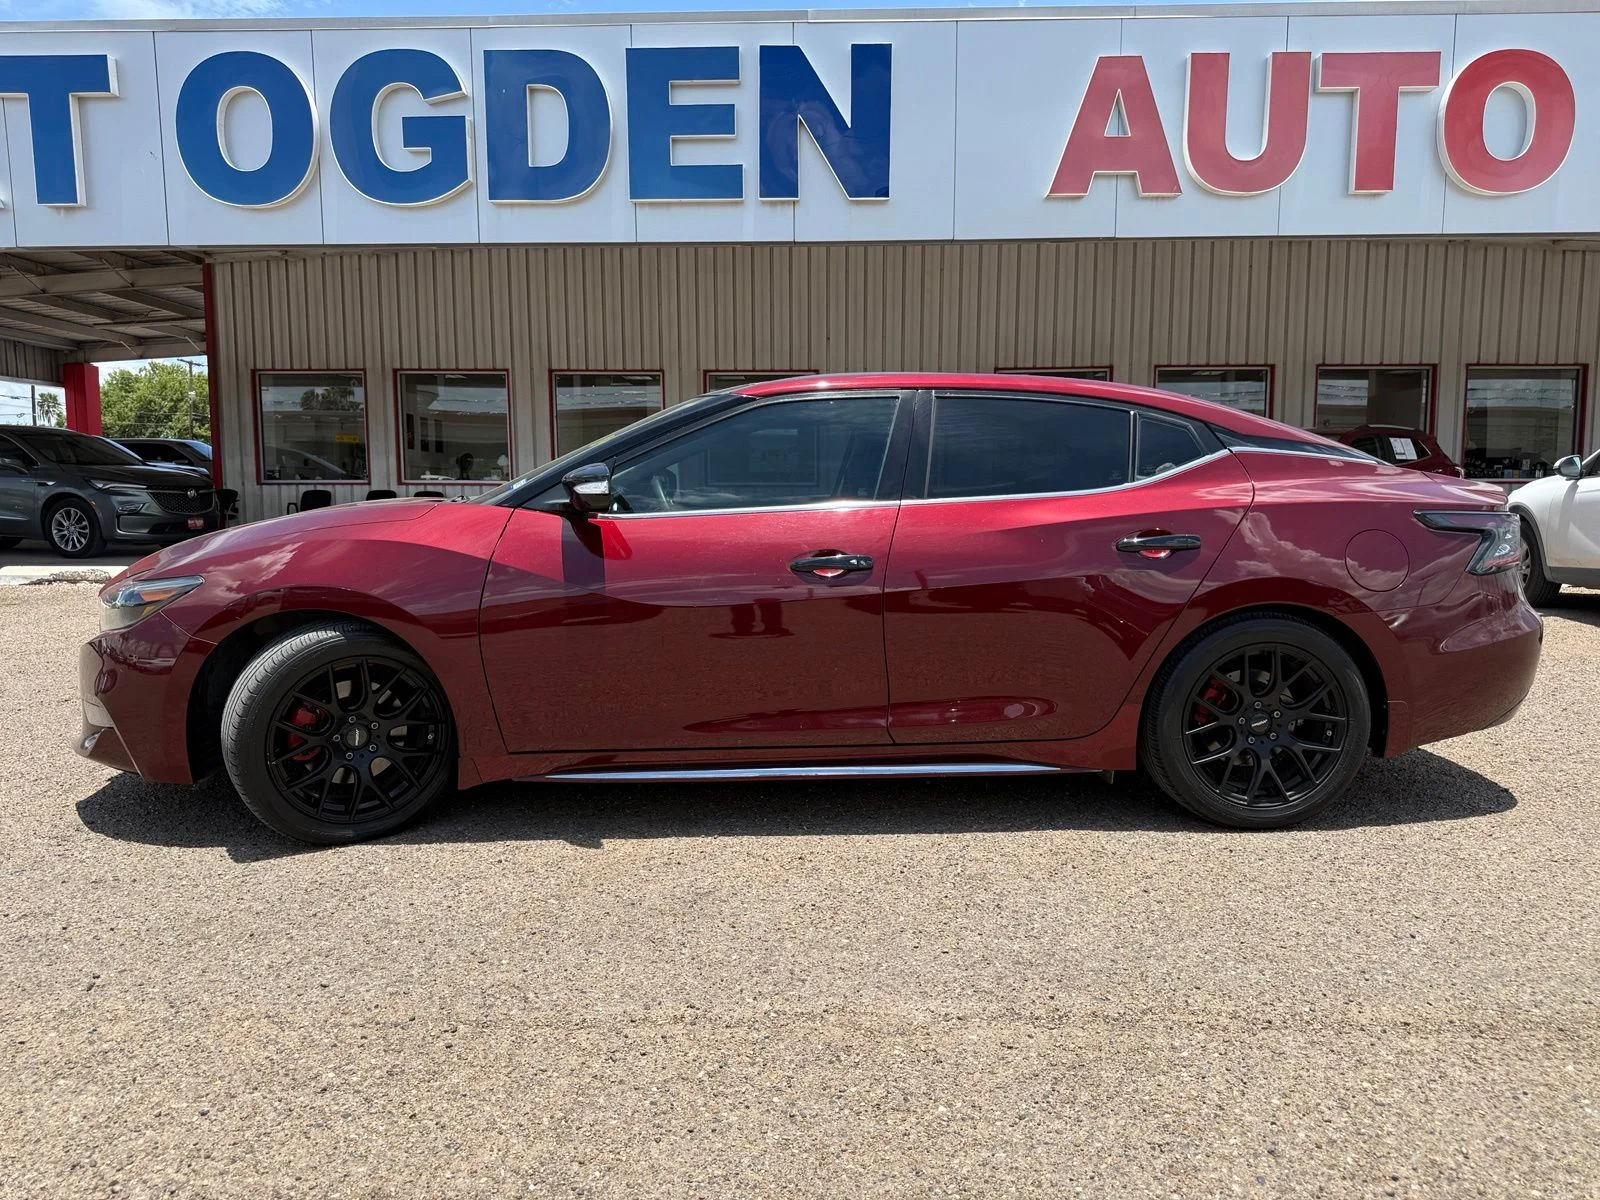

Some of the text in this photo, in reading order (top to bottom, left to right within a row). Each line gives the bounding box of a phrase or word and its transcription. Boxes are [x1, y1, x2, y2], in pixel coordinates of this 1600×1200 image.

[0, 44, 1576, 208] T OGDEN AUTO
